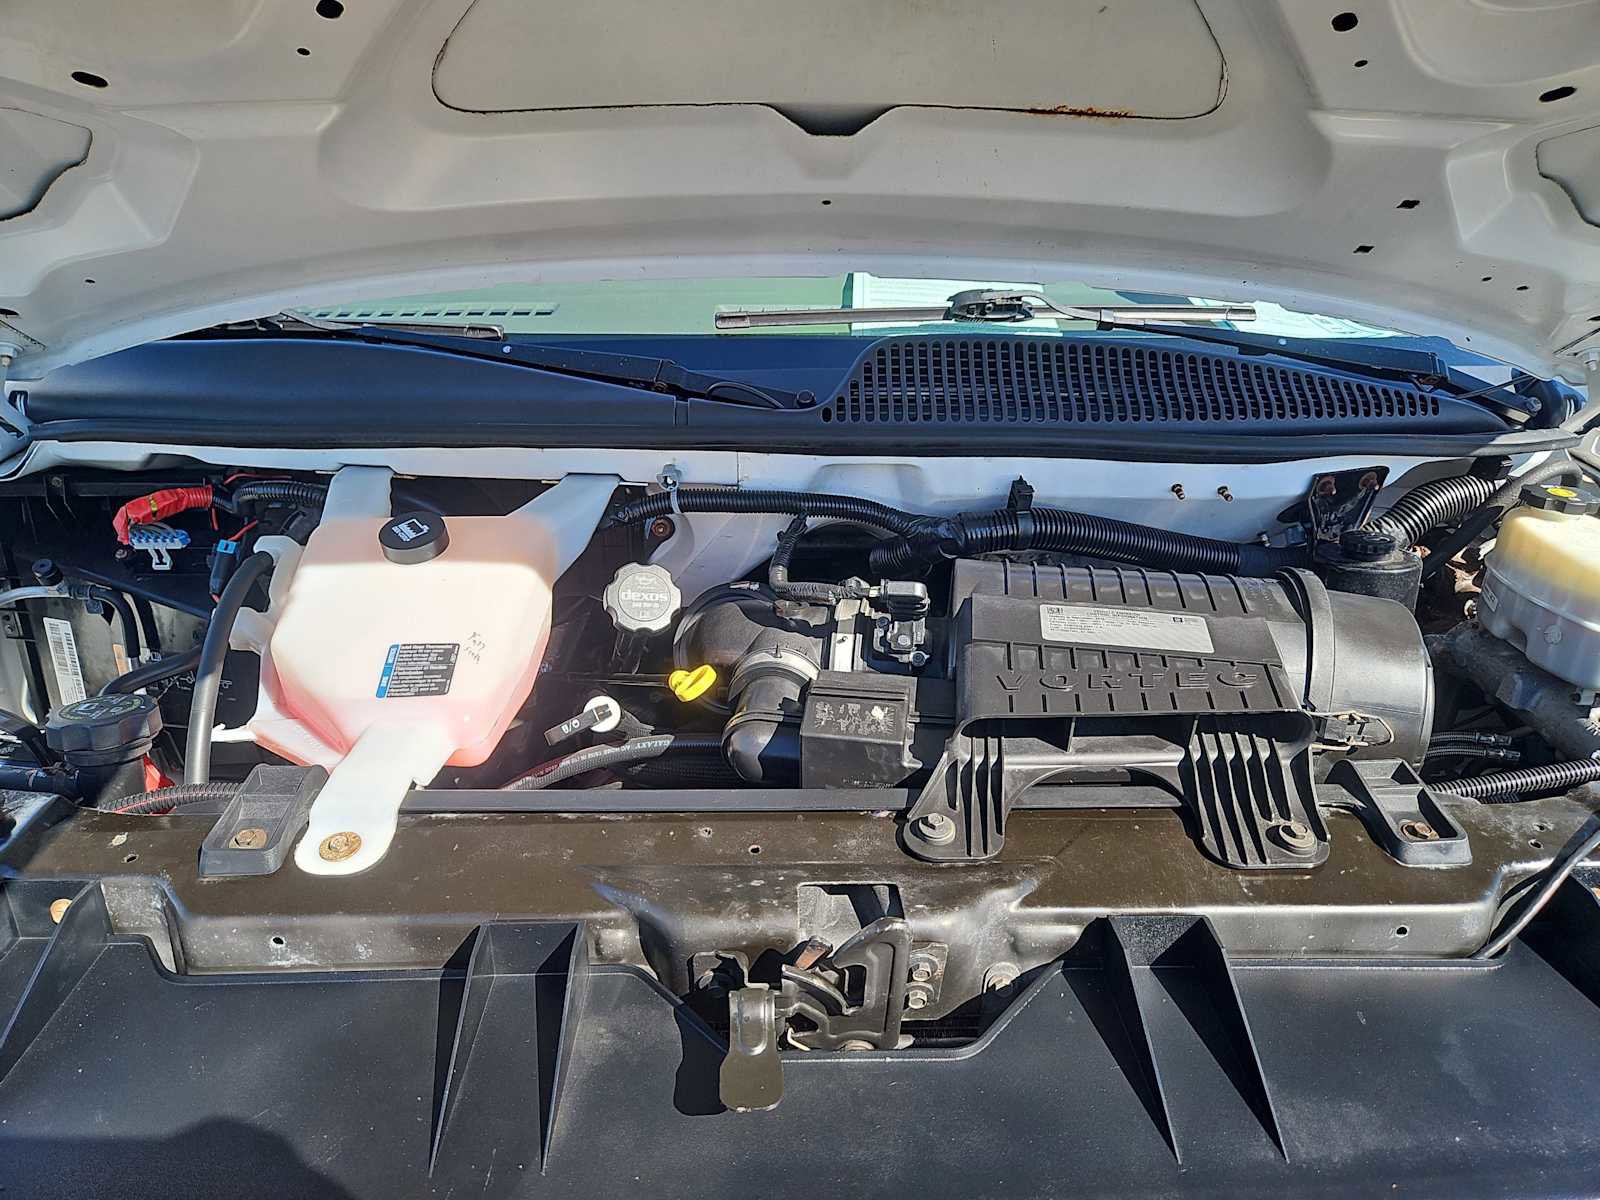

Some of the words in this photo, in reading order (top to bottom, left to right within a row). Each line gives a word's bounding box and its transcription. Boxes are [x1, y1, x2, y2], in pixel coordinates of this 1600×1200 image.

[621, 589, 669, 602] dexos
[995, 672, 1257, 692] VORTEC
[637, 739, 671, 749] GALAXY
